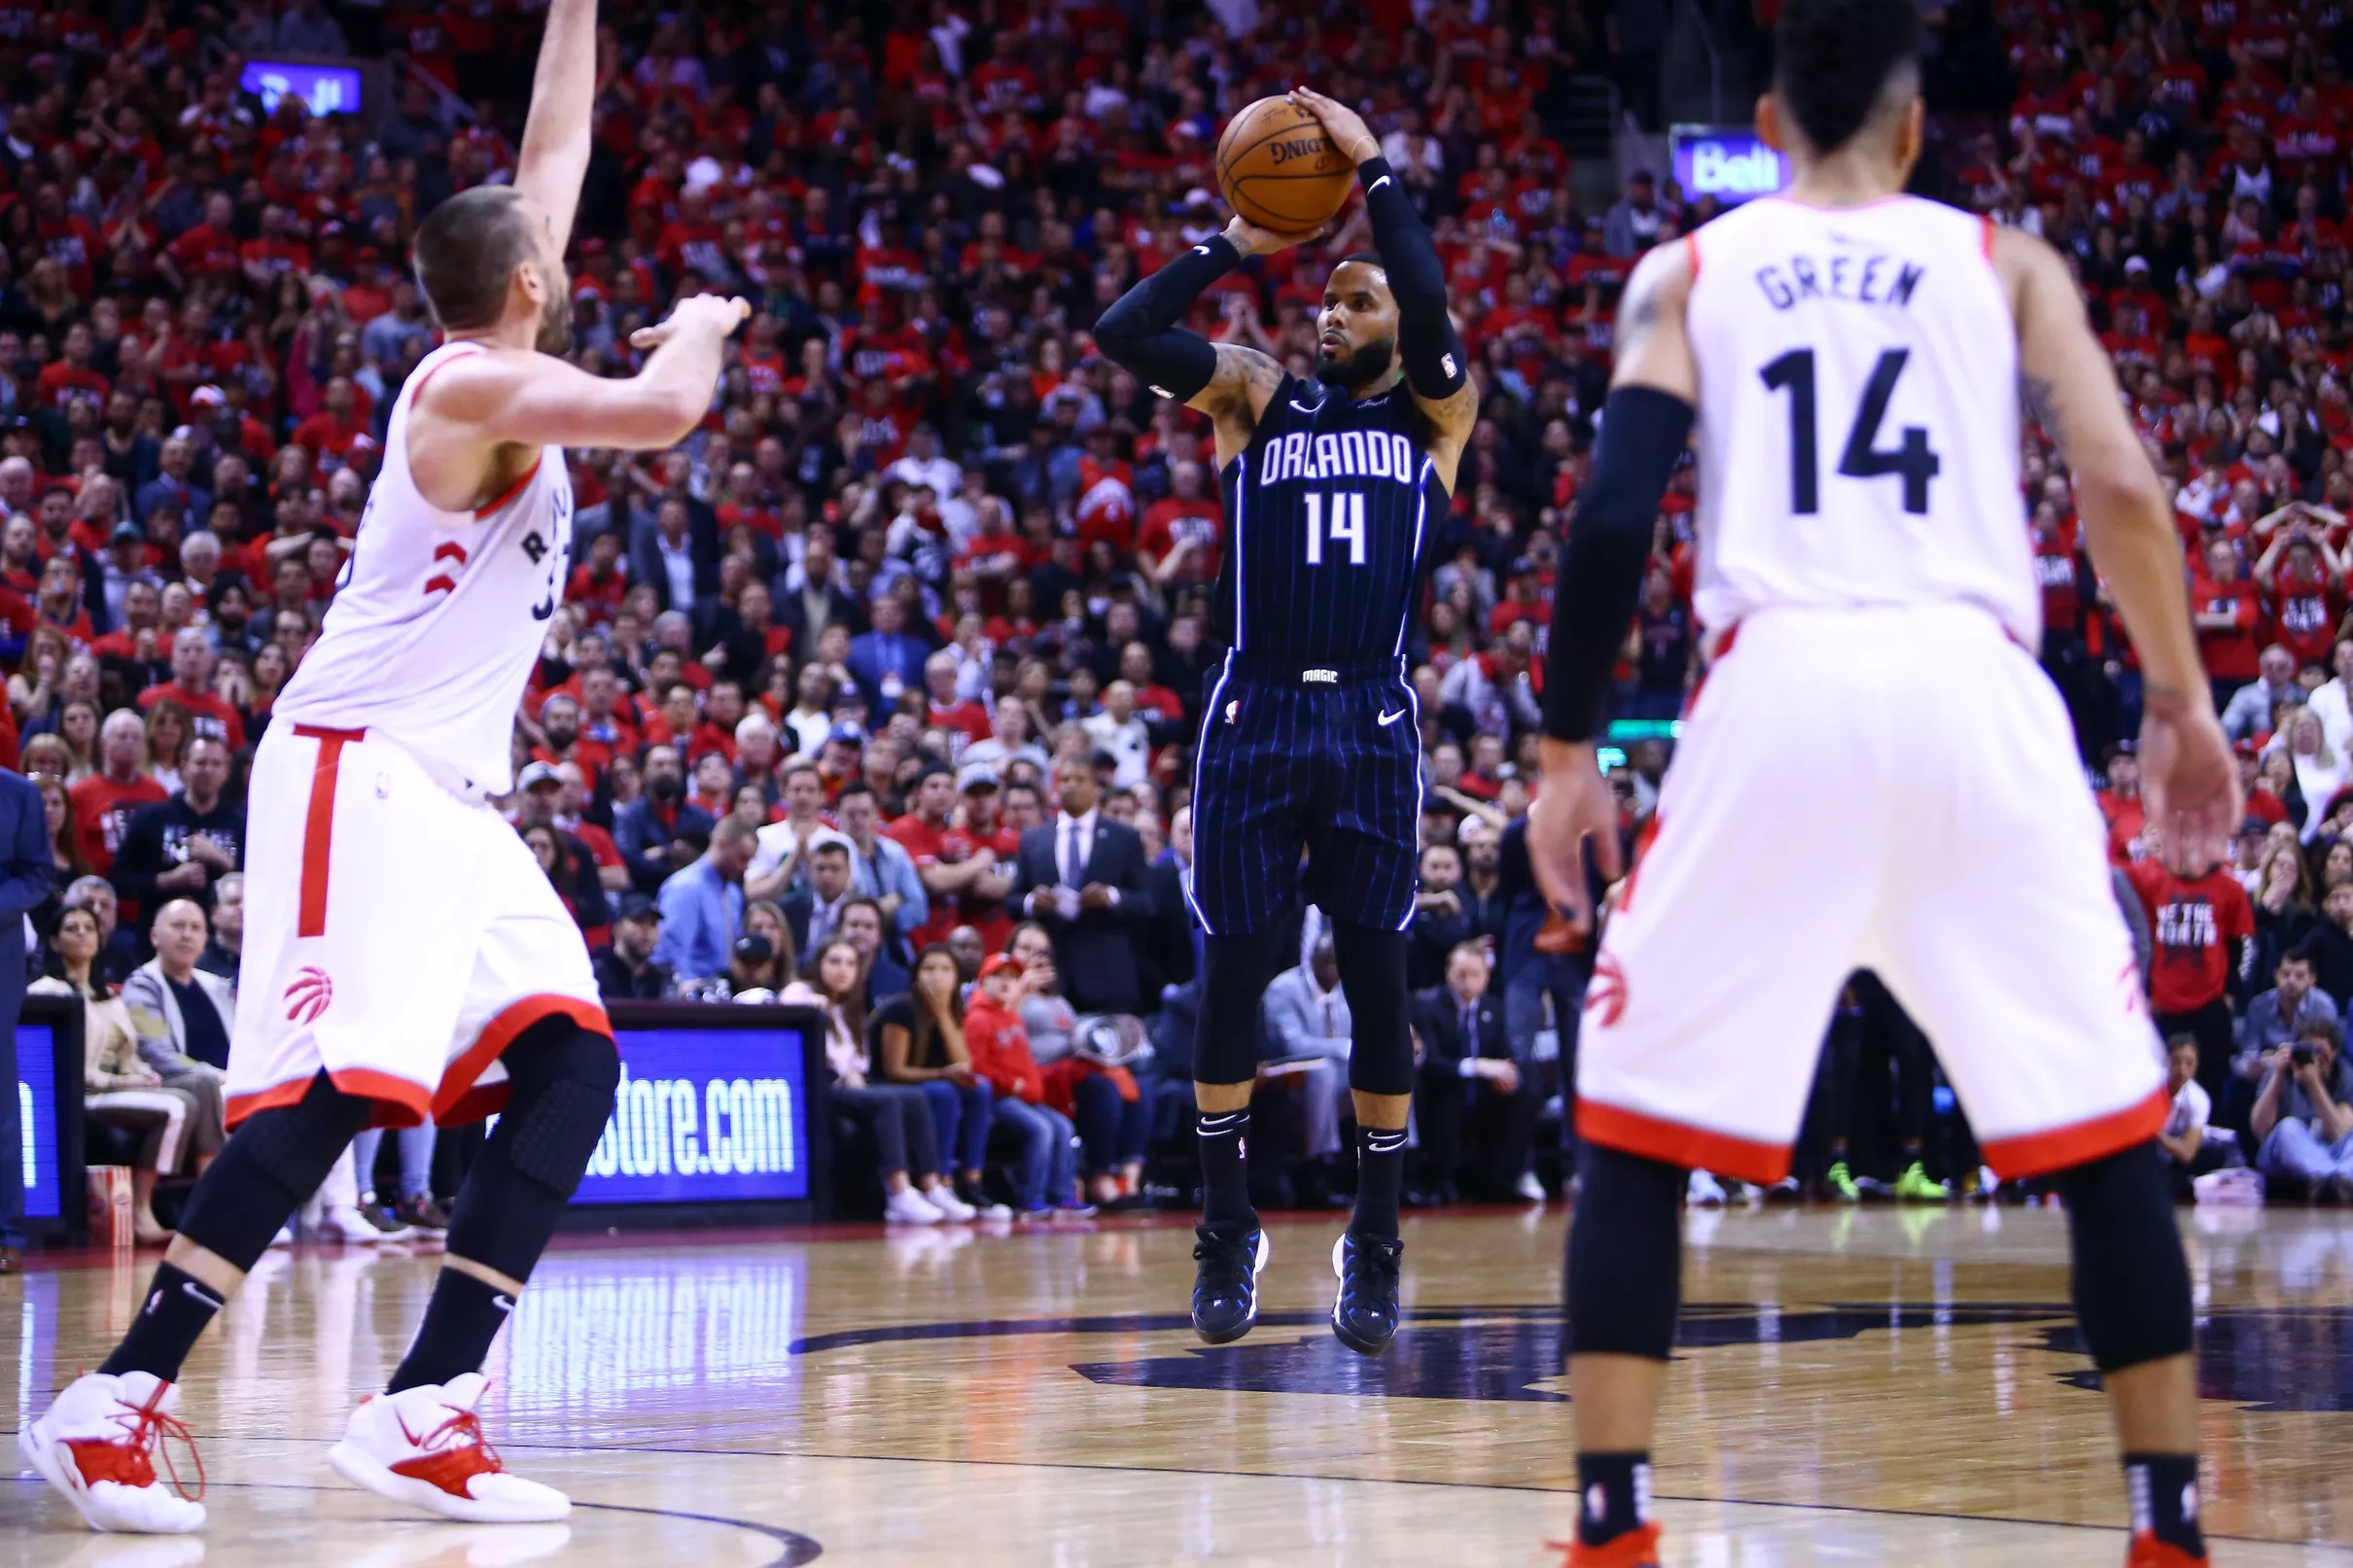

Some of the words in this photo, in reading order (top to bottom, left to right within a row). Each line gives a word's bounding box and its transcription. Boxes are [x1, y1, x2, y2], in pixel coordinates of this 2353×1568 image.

[1691, 141, 1780, 192] Bell
[1755, 255, 1924, 310] GREEN
[1261, 430, 1413, 486] ORLANDO
[1759, 347, 1941, 515] 14
[1304, 492, 1365, 565] 14
[1302, 668, 1339, 683] MAGIC
